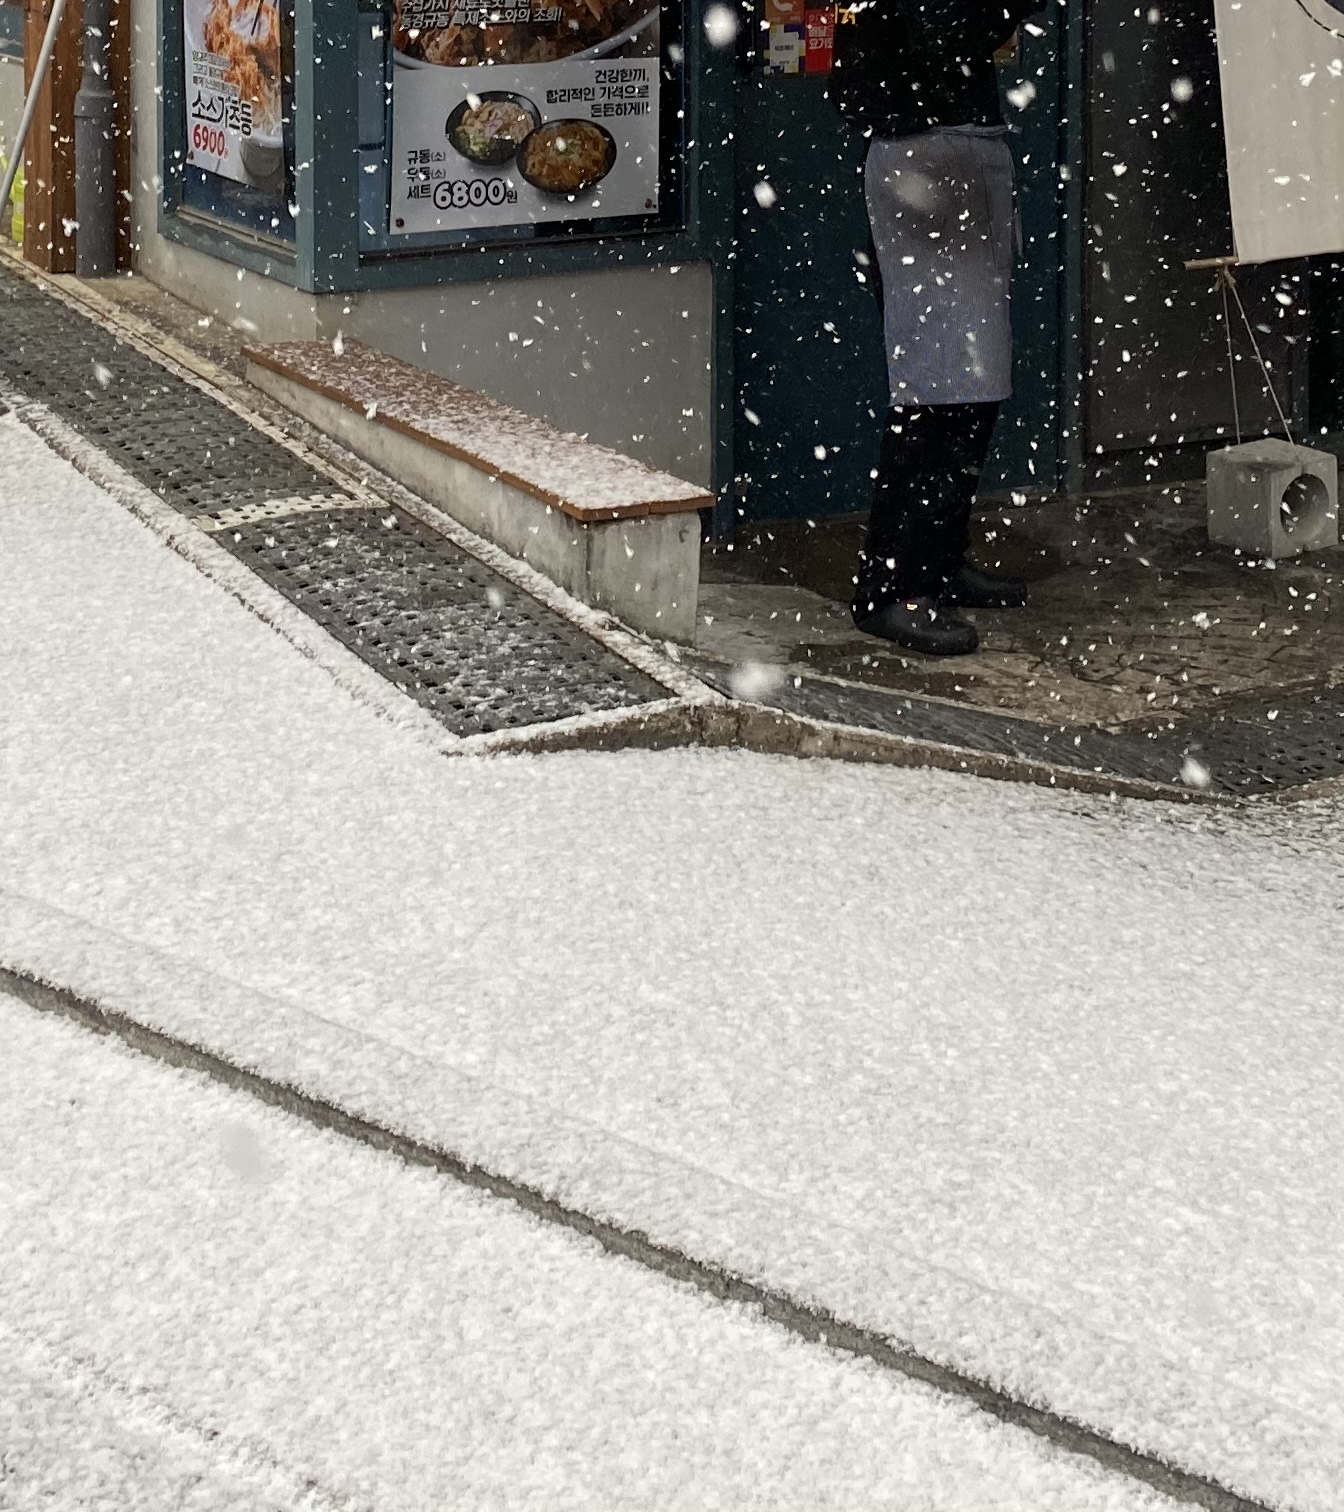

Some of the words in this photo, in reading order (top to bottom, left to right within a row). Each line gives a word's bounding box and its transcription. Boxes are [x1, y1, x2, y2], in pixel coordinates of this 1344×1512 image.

[546, 87, 595, 105] 합리적인
[599, 84, 650, 101] 가격으로
[191, 89, 253, 138] 소스가츠동
[407, 149, 446, 166] 규동(소)
[407, 184, 432, 201] 세트
